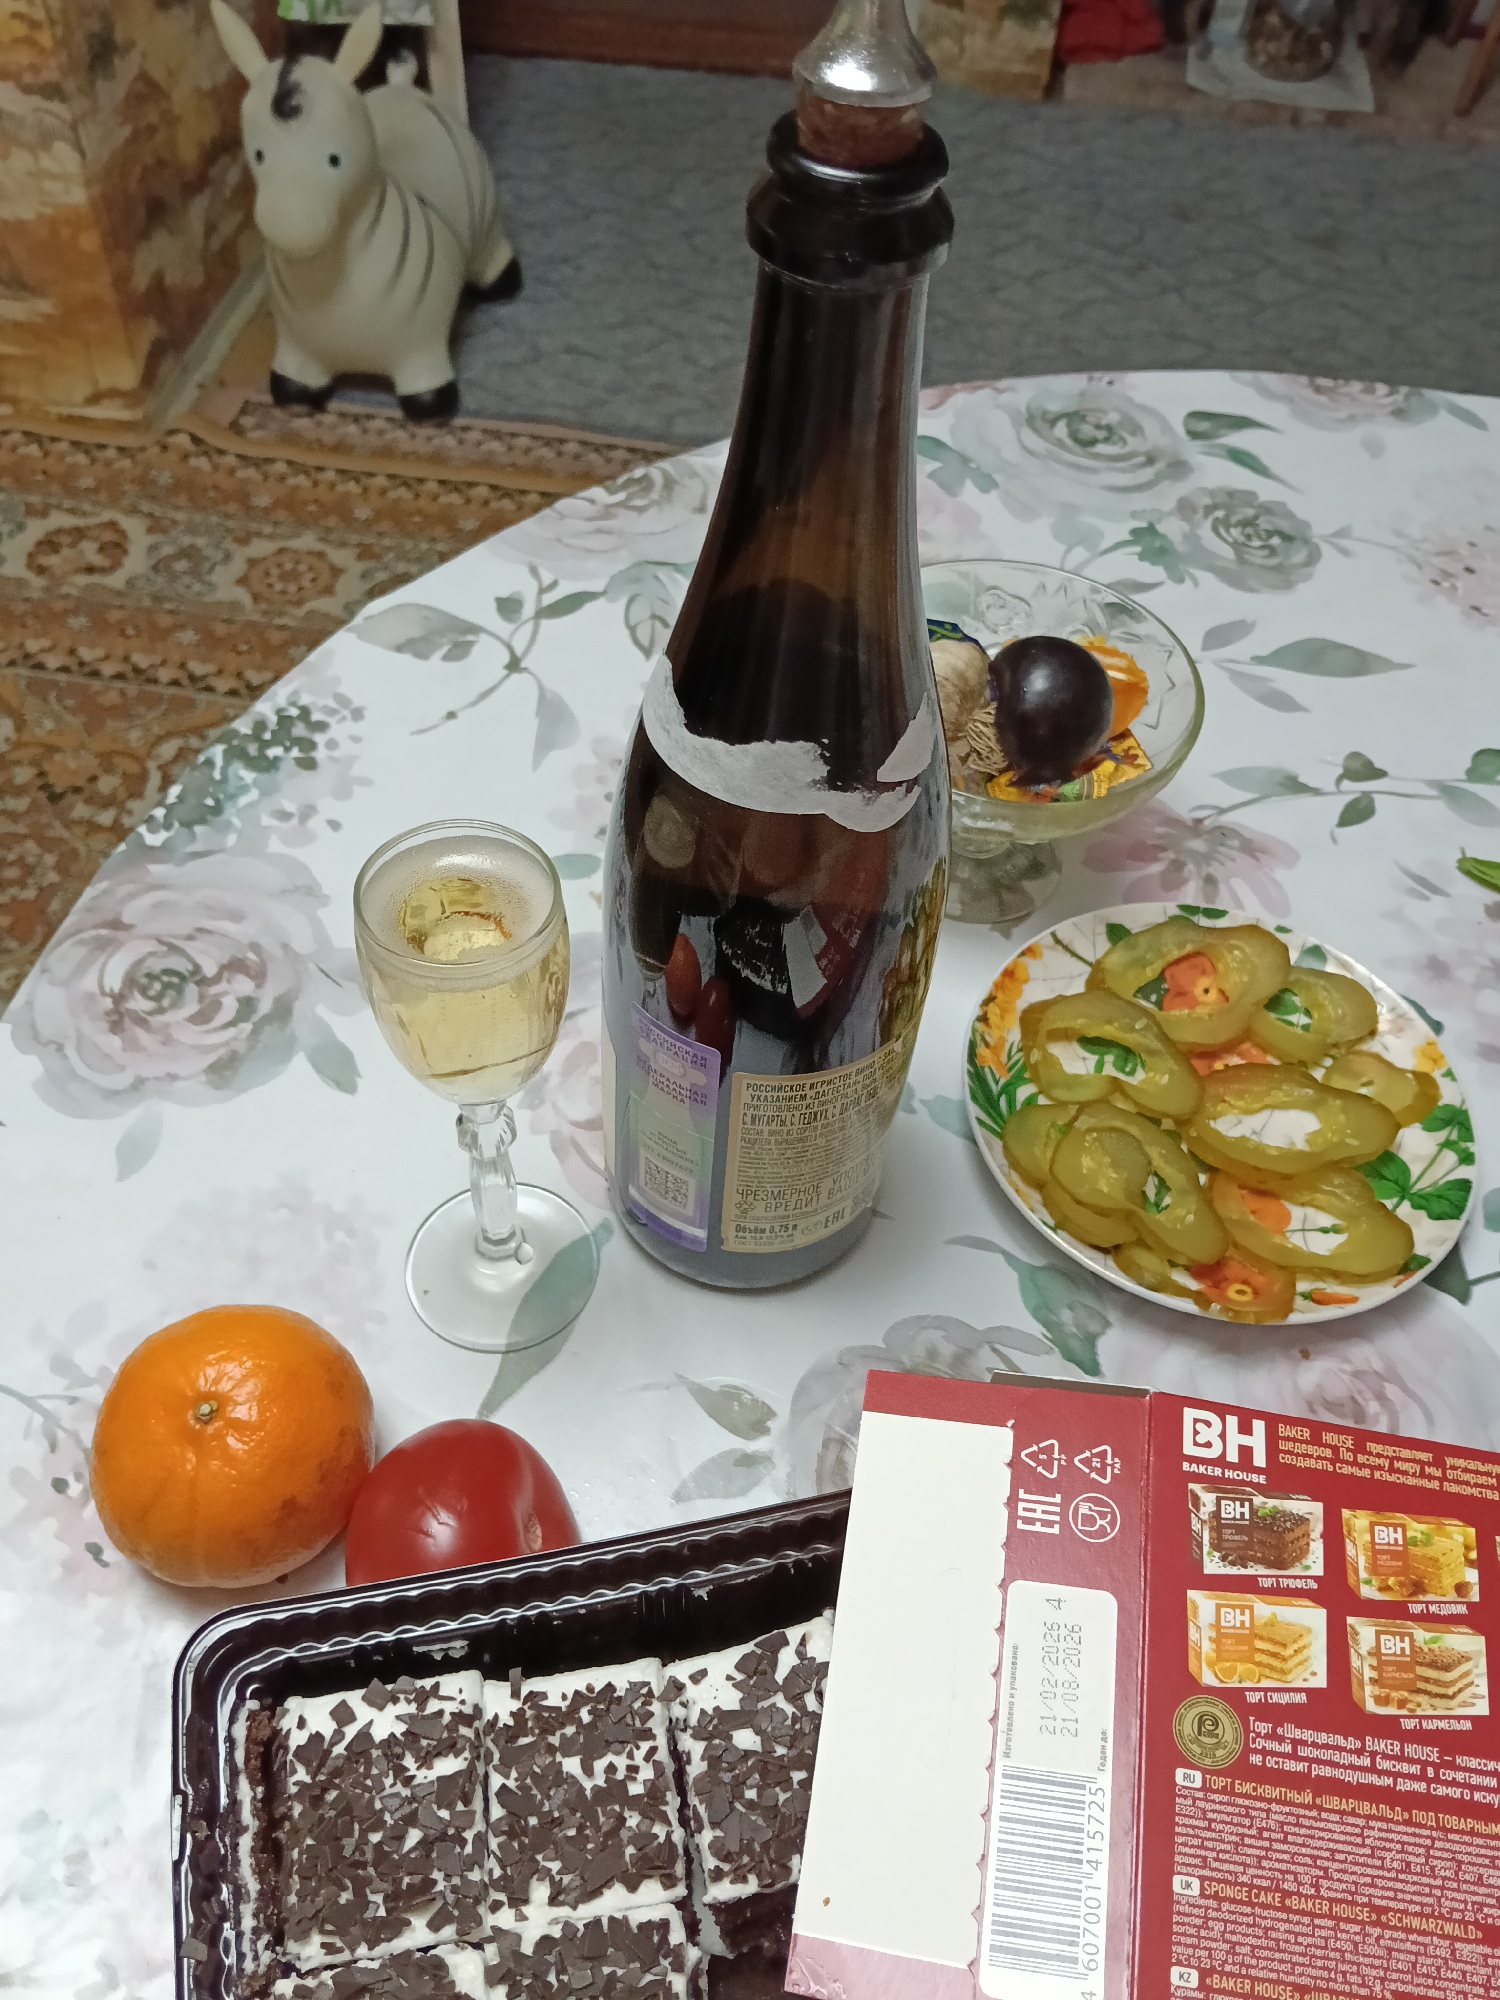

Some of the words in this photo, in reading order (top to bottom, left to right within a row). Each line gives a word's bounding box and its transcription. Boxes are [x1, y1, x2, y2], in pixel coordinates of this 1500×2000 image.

[746, 1083, 807, 1093] РОССИЙСКОЕ
[809, 1071, 853, 1091] ИГРИСТОЕ
[855, 1060, 875, 1077] ВИНО
[652, 1081, 685, 1104] МАРКА
[750, 1093, 807, 1103] УКАЗАНИЕМ
[810, 1080, 860, 1100] «ДАГЕСТАН»
[743, 1102, 803, 1113] ПРИГОТОВЛЕНО
[805, 1101, 815, 1110] ИЗ
[736, 1181, 823, 1202] ЧРЕЗМЕРНОЕ
[764, 1194, 820, 1212] ВРЕДИТ
[735, 1223, 766, 1234] Объём
[1183, 1407, 1266, 1468] BH
[1278, 1424, 1310, 1441] BAKER
[1322, 1431, 1355, 1449] HOUSE
[1366, 1442, 1433, 1462] представляет
[1061, 1454, 1067, 1465] PP
[1092, 1457, 1101, 1468] 21
[1279, 1441, 1334, 1460] шедевров.
[1340, 1449, 1354, 1463] По
[1357, 1454, 1389, 1472] всему
[1394, 1461, 1420, 1478] миру
[1425, 1466, 1442, 1478] мы
[1446, 1469, 1497, 1488] отбираем
[1182, 1461, 1223, 1477] BAKER
[1224, 1468, 1267, 1484] HOUSE
[1279, 1454, 1333, 1472] создавать
[1336, 1464, 1371, 1478] самые
[1374, 1470, 1440, 1490] изысканные
[1443, 1482, 1500, 1501] лакомства
[1220, 1500, 1250, 1520] BH
[1374, 1525, 1403, 1545] BH
[1258, 1577, 1277, 1588] ТОРТ
[1278, 1578, 1318, 1589] ТРЮФЕЛЬ
[1220, 1607, 1250, 1628] BH
[1407, 1603, 1426, 1614] ТОРТ
[1428, 1604, 1468, 1615] МЕДОВИК
[1380, 1634, 1410, 1655] BH
[1039, 1621, 1061, 1736] 21/02/2026
[1060, 1623, 1082, 1738] 21/08/2026
[1002, 1700, 1015, 1759] Изготовлено
[1010, 1643, 1019, 1691] упаковано:
[1245, 1691, 1264, 1703] ТОРТ
[1267, 1692, 1307, 1705] СИЦИЛИЯ
[1100, 1728, 1108, 1743] до:
[1400, 1718, 1420, 1729] ТОРТ
[1422, 1719, 1472, 1731] КАРМЕЛЬОН
[1249, 1717, 1272, 1737] Торт
[1277, 1722, 1362, 1751] «Шварцвальд»
[1366, 1736, 1400, 1756] BAKER
[1404, 1742, 1440, 1762] HOUSE
[1097, 1744, 1107, 1772] Годен
[1250, 1733, 1292, 1755] Сочный
[1298, 1745, 1371, 1767] шоколадный
[1376, 1754, 1421, 1776] бисквит
[1427, 1766, 1434, 1778] в
[1440, 1768, 1498, 1788] сочетании
[1183, 1772, 1195, 1784] RU
[1250, 1753, 1262, 1766] не
[1266, 1756, 1310, 1774] оставит
[1312, 1764, 1393, 1788] равнодушным
[1396, 1777, 1427, 1793] даже
[1430, 1783, 1470, 1800] самого
[1205, 1775, 1232, 1792] ТОРТ
[1235, 1780, 1312, 1805] БИСКВИТНЫЙ
[1316, 1794, 1409, 1822] «ШВАРЦВАЛЬД»
[1412, 1809, 1436, 1828] ПОД
[1438, 1814, 1500, 1836] ТОВАРНЫМ
[1086, 1786, 1106, 1872] 415725
[1174, 1855, 1203, 1866] арахис.
[1207, 1858, 1243, 1872] Пищевая
[1246, 1867, 1282, 1879] ценность
[1285, 1873, 1294, 1881] на
[1297, 1873, 1310, 1883] 100
[1319, 1879, 1355, 1891] продукта
[1174, 1864, 1235, 1883] (калорийность)
[1237, 1874, 1250, 1883] 340
[1253, 1878, 1271, 1887] ккал
[1280, 1881, 1298, 1891] 1450
[1300, 1885, 1317, 1895] кДж.
[1181, 1879, 1193, 1891] UK
[1204, 1881, 1249, 1902] SPONGE
[1252, 1889, 1282, 1907] CAKE
[1285, 1896, 1330, 1915] «BAKER
[1333, 1902, 1377, 1923] HOUSE»
[1381, 1912, 1483, 1941] «SCHWARZWALD»
[1082, 1884, 1101, 1972] 607001
[1174, 1893, 1220, 1908] Ingredients:
[1221, 1902, 1287, 1920] glucose-fructose
[1289, 1914, 1312, 1926] syrup;
[1314, 1918, 1336, 1930] water;
[1340, 1923, 1364, 1935] sugar;
[1366, 1925, 1382, 1937] high
[1384, 1930, 1406, 1939] grade
[1408, 1933, 1432, 1944] wheat
[1433, 1936, 1452, 1949] flour;
[1454, 1942, 1492, 1954] vegetable
[1174, 1903, 1204, 1916] (refined
[1207, 1909, 1253, 1924] deodorized
[1256, 1917, 1312, 1934] hydrogenated
[1315, 1928, 1334, 1938] palm
[1338, 1931, 1363, 1942] kernel
[1381, 1940, 1424, 1953] emulsifiers
[1179, 1971, 1191, 1983] KZ
[1206, 1974, 1251, 1994] «BAKER
[1255, 1981, 1300, 2000] HOUSE»
